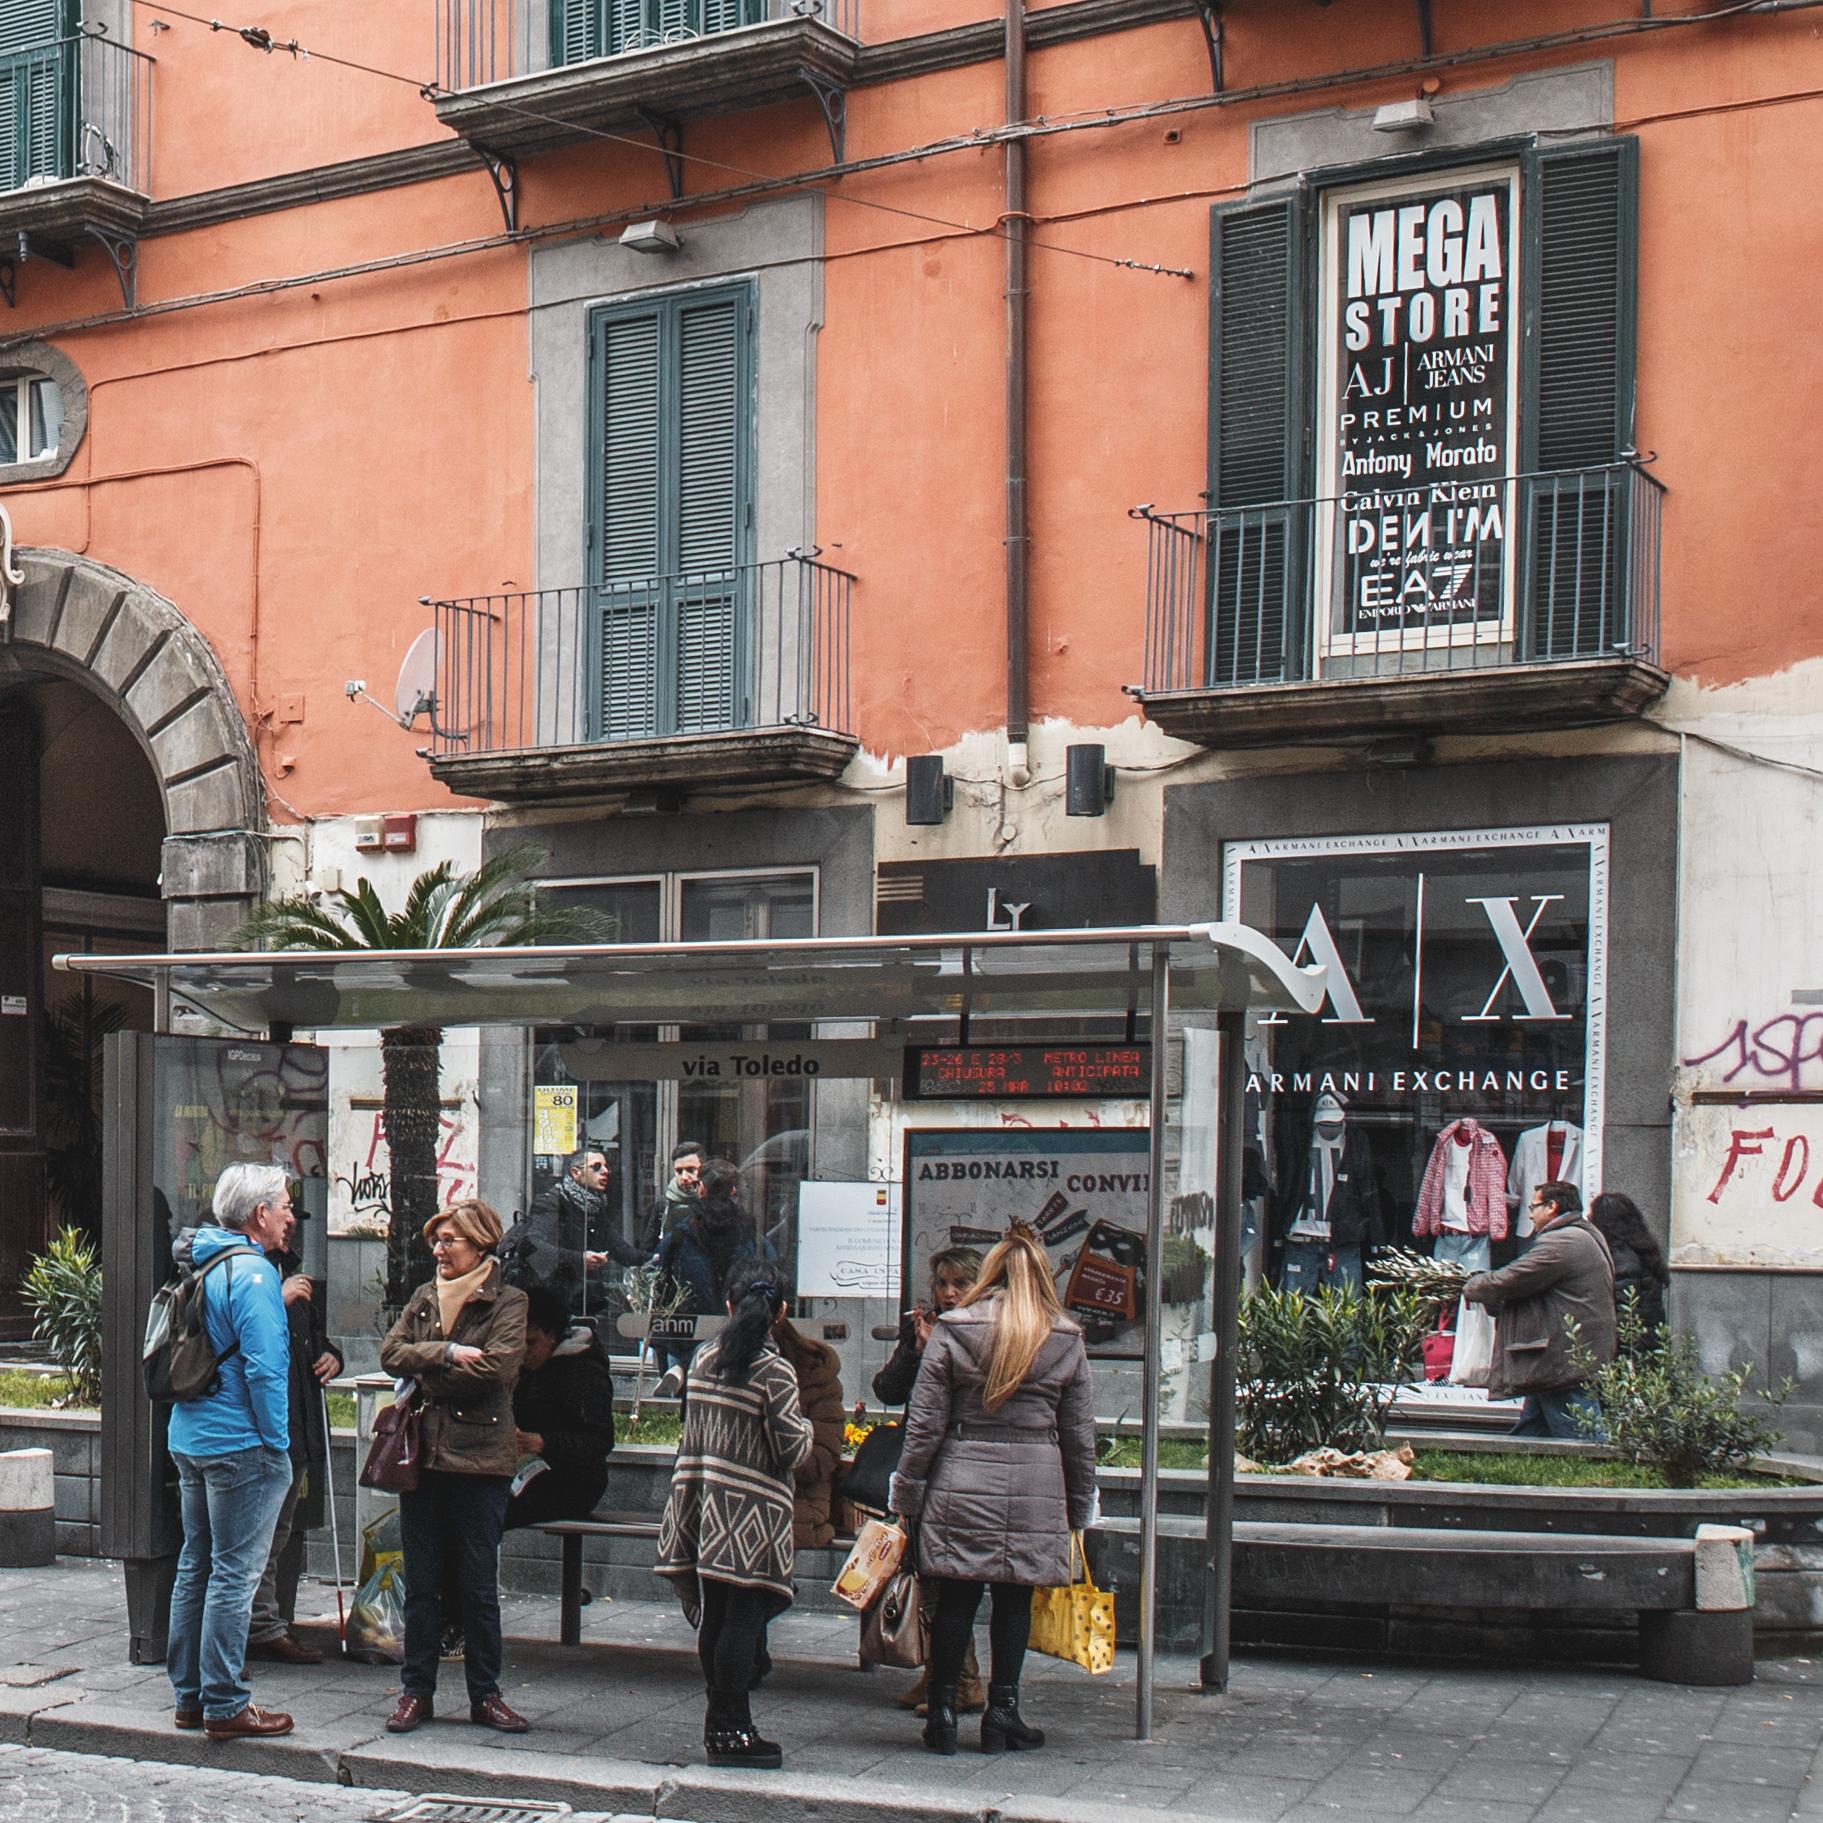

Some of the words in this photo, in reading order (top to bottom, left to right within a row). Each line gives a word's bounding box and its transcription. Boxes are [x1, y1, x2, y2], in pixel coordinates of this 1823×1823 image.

[1348, 194, 1502, 298] MEGA
[1345, 282, 1500, 351] STORE
[1417, 344, 1494, 371] ARMANI
[1341, 356, 1394, 400] AJ
[1425, 365, 1486, 390] JEANS
[1340, 397, 1492, 431] PREMIUM
[1341, 448, 1411, 478] Antony
[1426, 436, 1497, 468] Morato
[1340, 488, 1421, 512] Calvin
[1431, 480, 1497, 504] Klein
[1361, 563, 1473, 607] EA7
[1326, 838, 1387, 849] EXCHANGE
[1422, 835, 1471, 844] ARMANI
[1477, 830, 1540, 842] EXCHANGE
[682, 1055, 721, 1076] via
[730, 1054, 820, 1076] Toledo
[1044, 1052, 1087, 1064] METRO
[1095, 1051, 1141, 1064] LINEA
[936, 1066, 1005, 1079] CHIUSURA
[1052, 1065, 1141, 1078] ANTICIPATA
[1245, 1072, 1376, 1093] ARMANI
[1393, 1070, 1570, 1091] EXCHANGE
[978, 1081, 996, 1093] 25
[553, 1095, 573, 1106] 80
[918, 1160, 1059, 1181] ABBONARSI
[651, 1317, 695, 1334] anm
